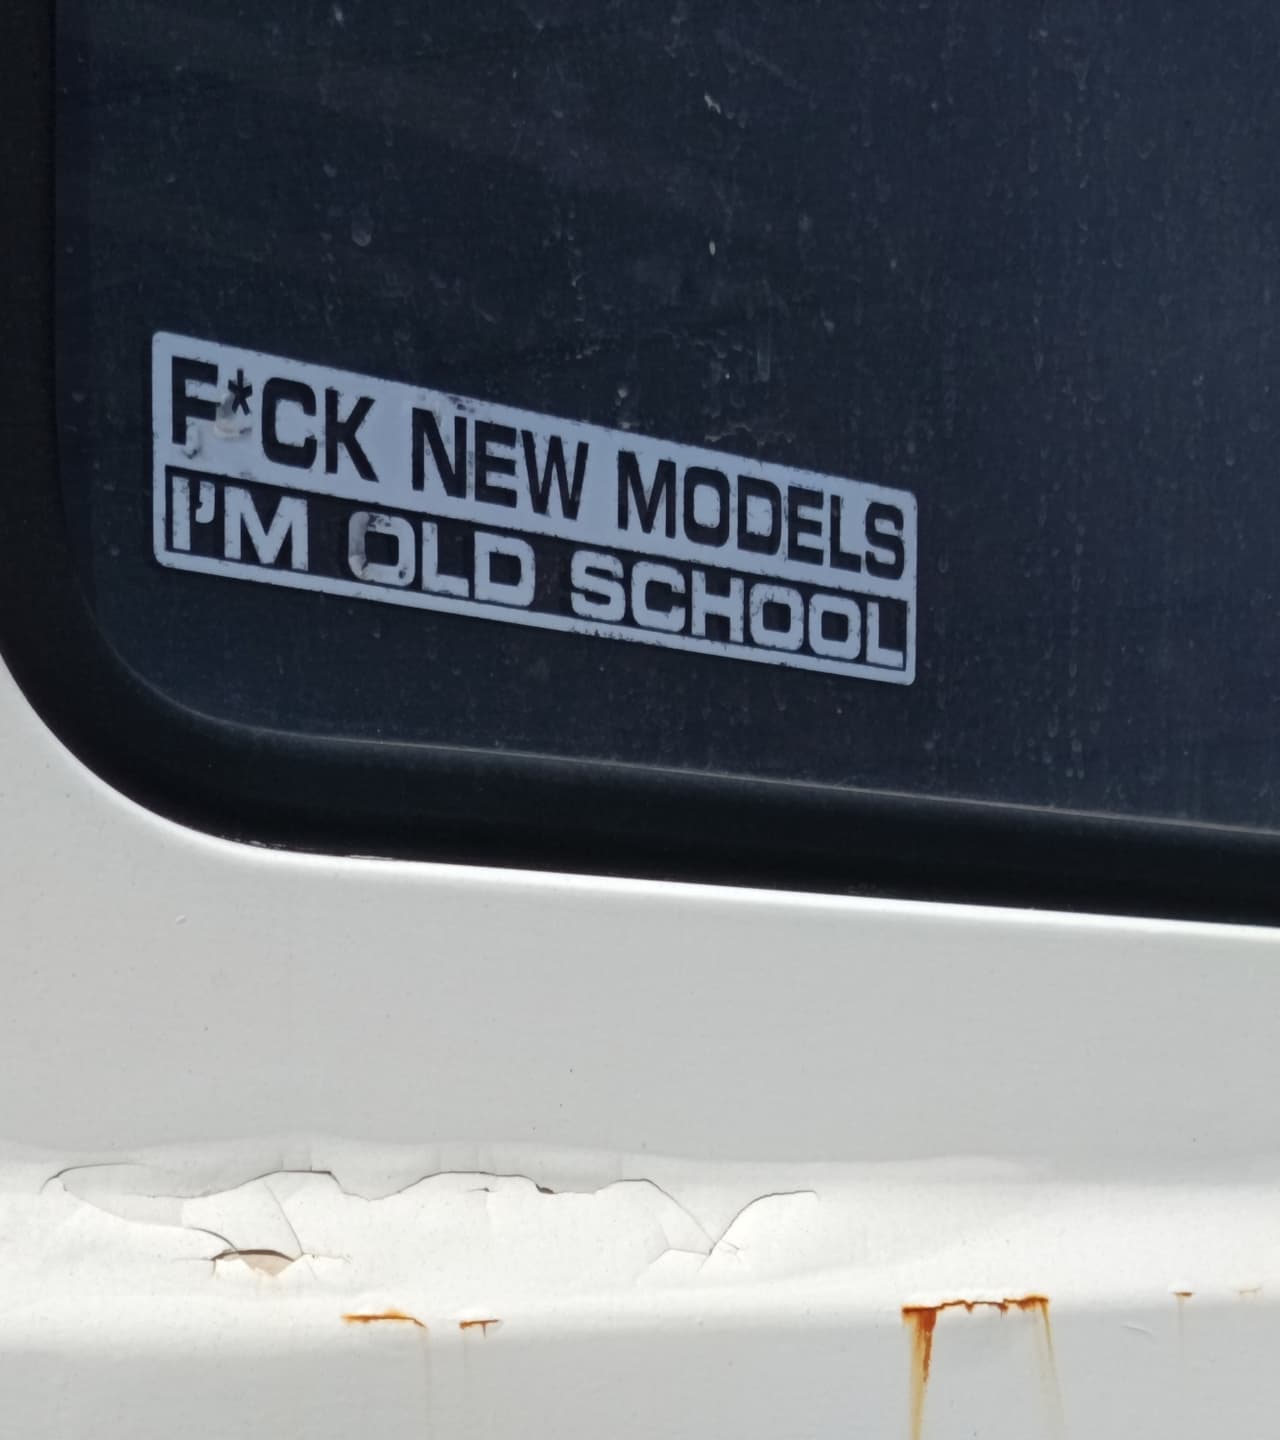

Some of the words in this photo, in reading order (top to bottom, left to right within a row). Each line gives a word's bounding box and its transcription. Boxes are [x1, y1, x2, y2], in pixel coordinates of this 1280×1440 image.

[171, 475, 309, 571] I'M
[348, 511, 537, 607] OLD
[570, 551, 904, 669] SCHOOL
[411, 407, 589, 520] NEW
[617, 451, 905, 580] MODELS
